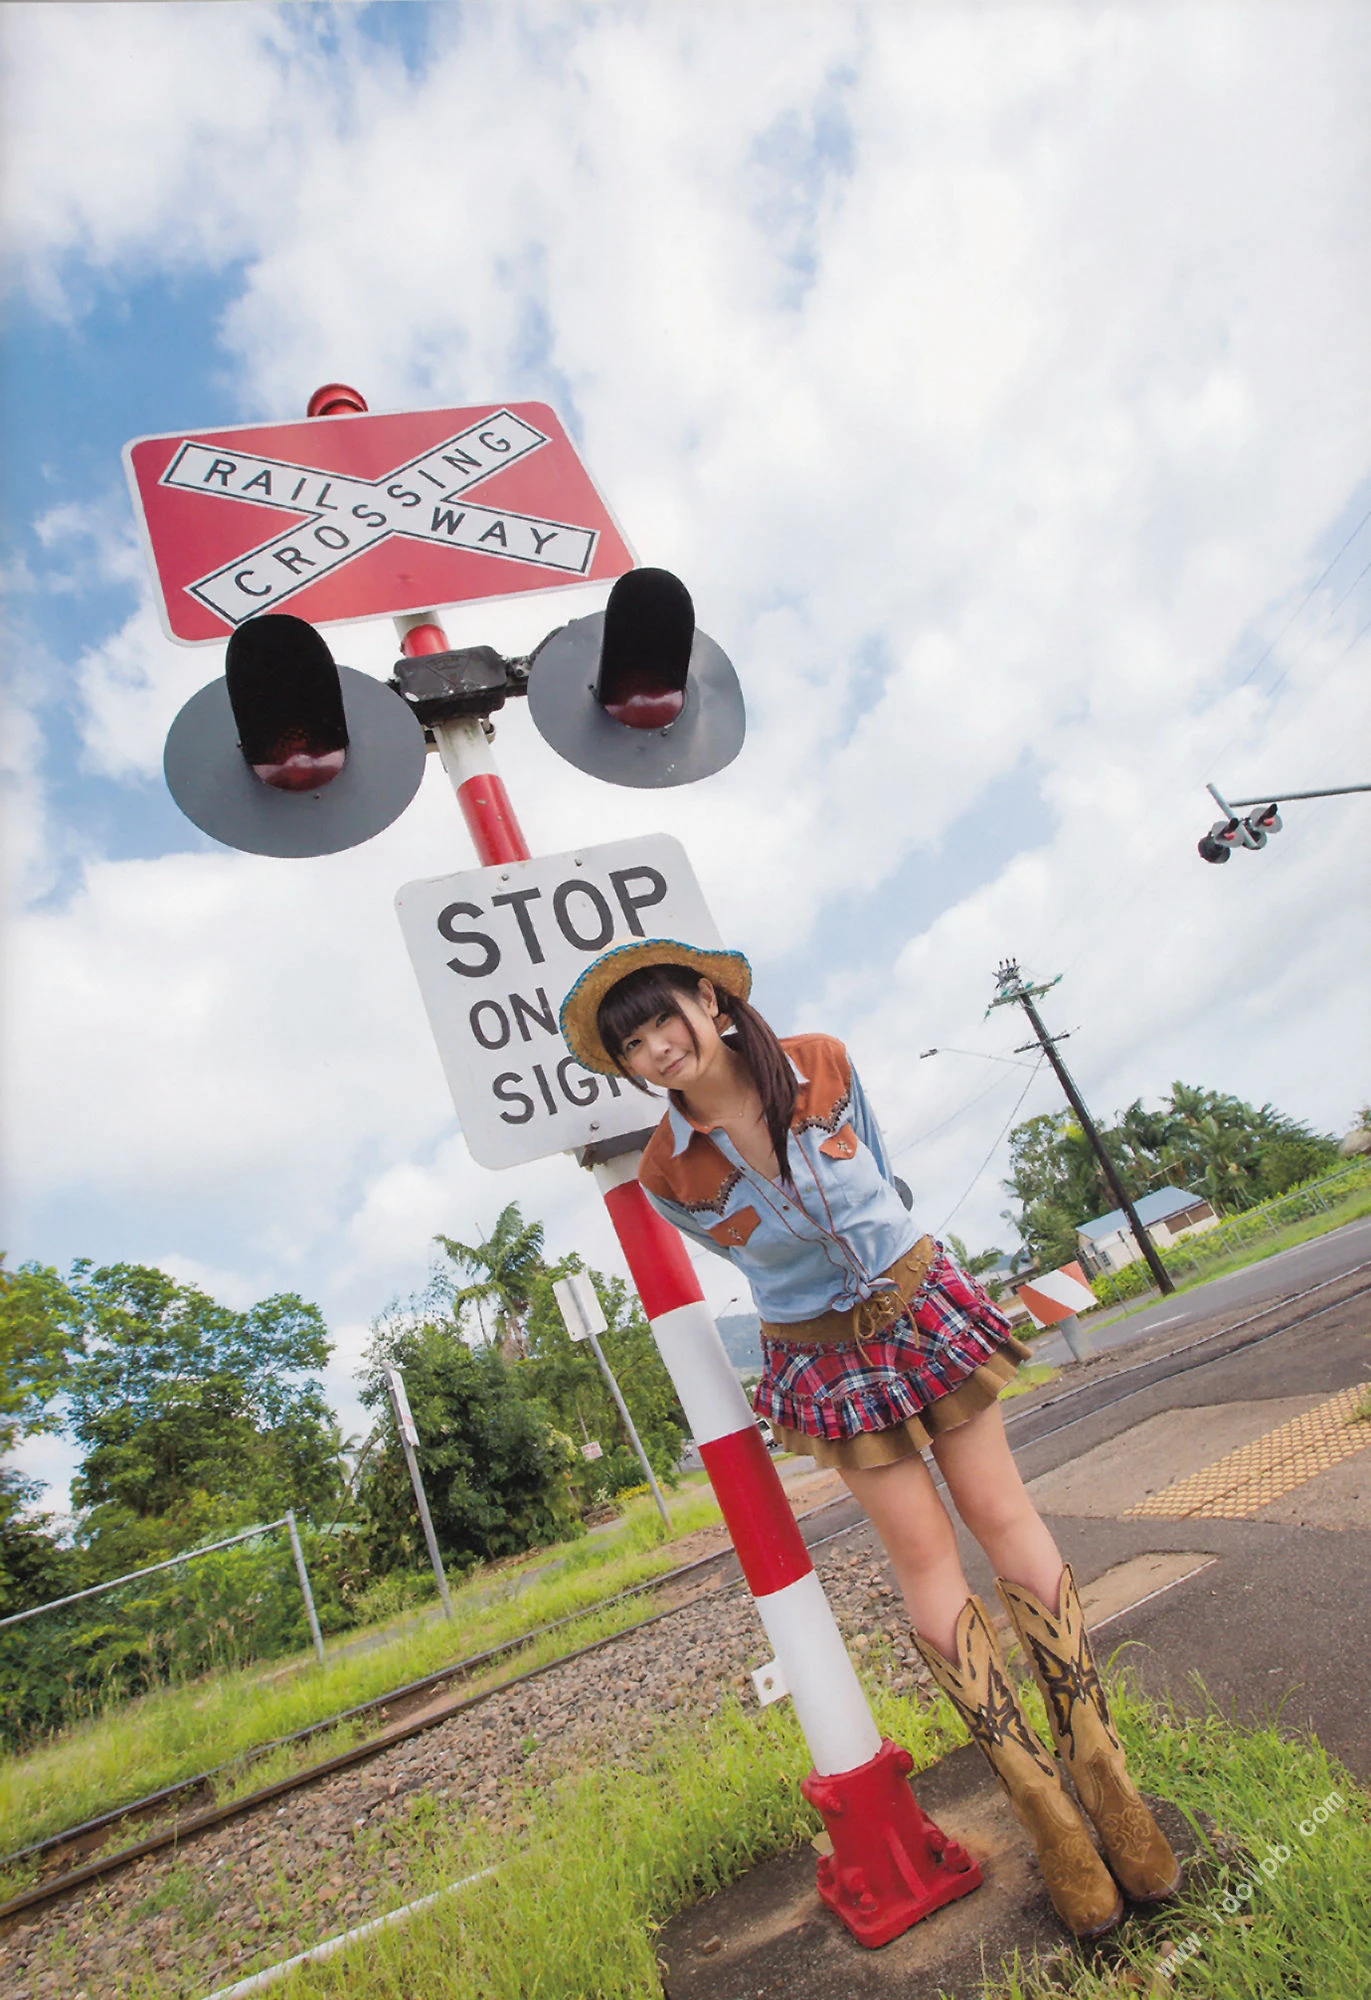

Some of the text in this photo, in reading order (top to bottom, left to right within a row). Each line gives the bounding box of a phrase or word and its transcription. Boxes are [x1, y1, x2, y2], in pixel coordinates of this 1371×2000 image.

[203, 459, 558, 556] RAIL WAY
[234, 430, 512, 599] CROSSING
[437, 865, 667, 978] STOP
[469, 987, 560, 1051] ON
